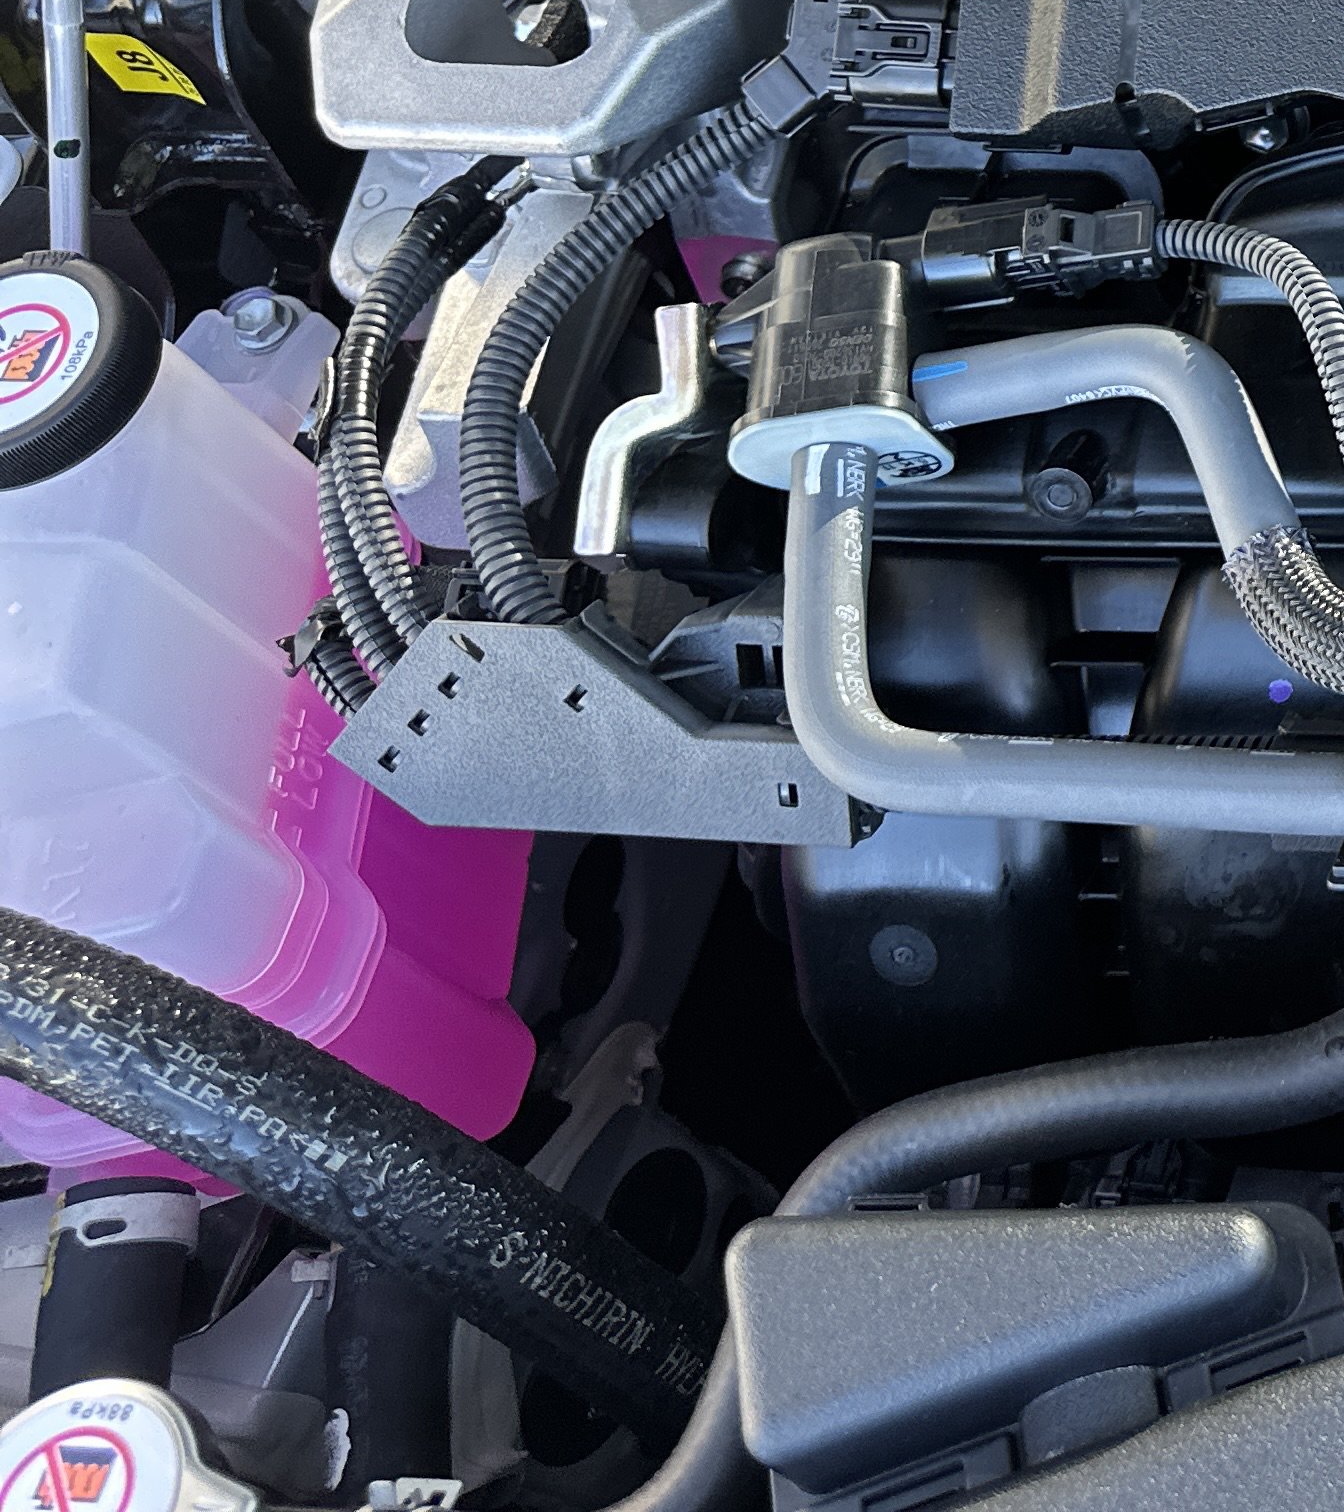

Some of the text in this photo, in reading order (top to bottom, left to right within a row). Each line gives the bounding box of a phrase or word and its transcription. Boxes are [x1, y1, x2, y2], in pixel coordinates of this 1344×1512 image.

[118, 49, 168, 84] J8
[60, 329, 95, 382] 108kPa
[267, 708, 308, 799] FULL
